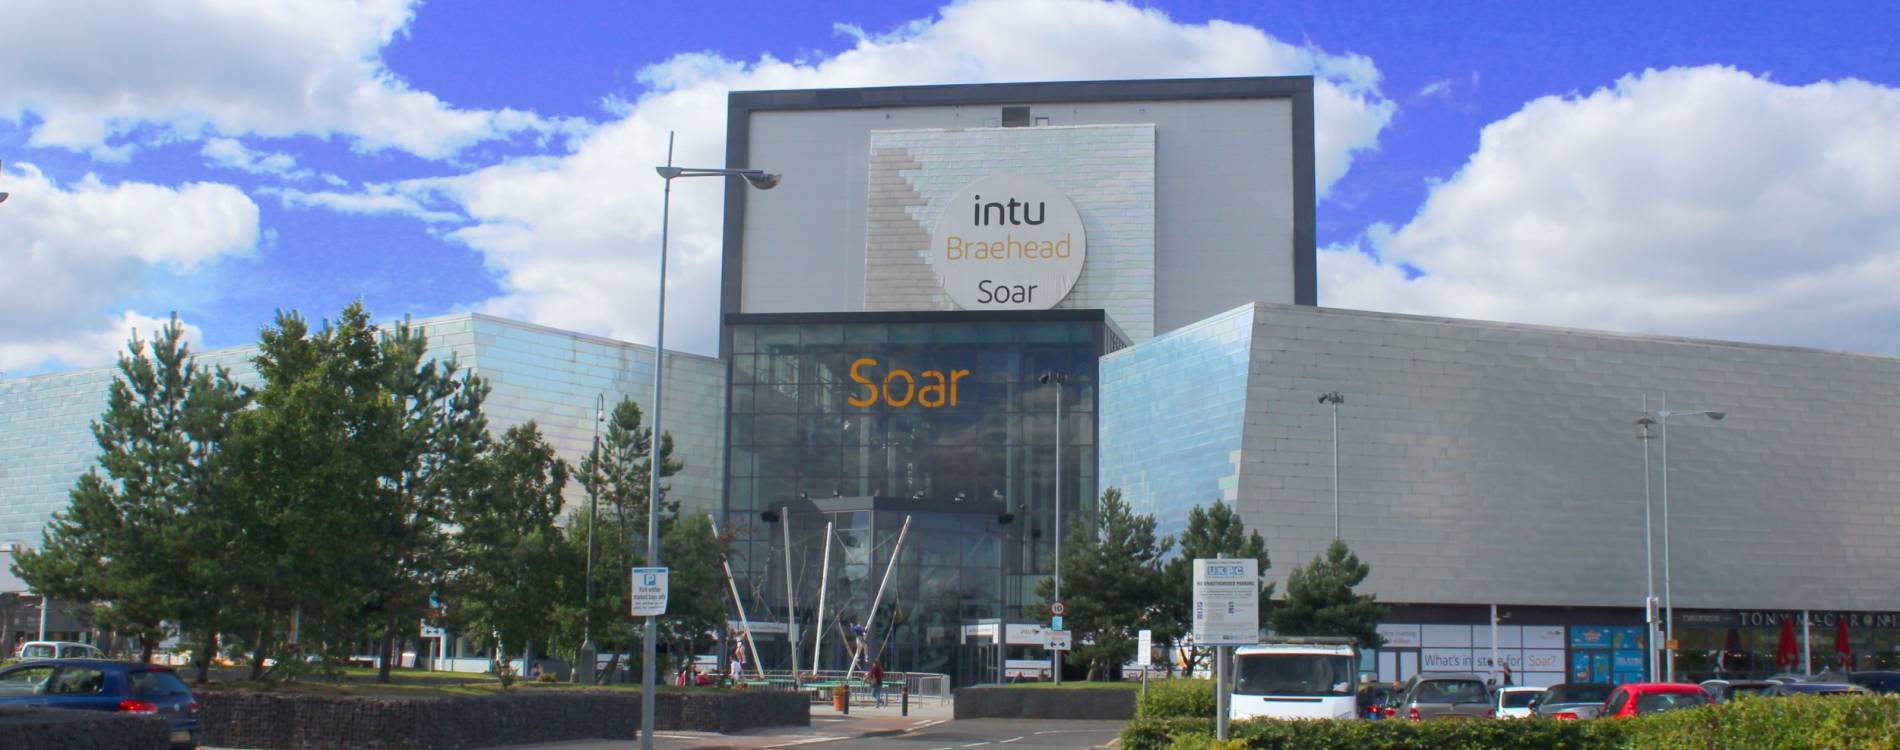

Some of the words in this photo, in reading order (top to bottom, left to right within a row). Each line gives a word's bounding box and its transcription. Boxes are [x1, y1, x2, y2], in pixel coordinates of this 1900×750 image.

[973, 195, 1046, 227] intu
[946, 233, 1072, 261] Braehead
[977, 279, 1038, 304] Soar
[847, 357, 971, 409] Soar
[1424, 654, 1460, 666] What's
[1462, 654, 1472, 666] in
[1477, 655, 1504, 667] ste
[1505, 654, 1521, 667] for
[1528, 655, 1556, 667] Soar?
